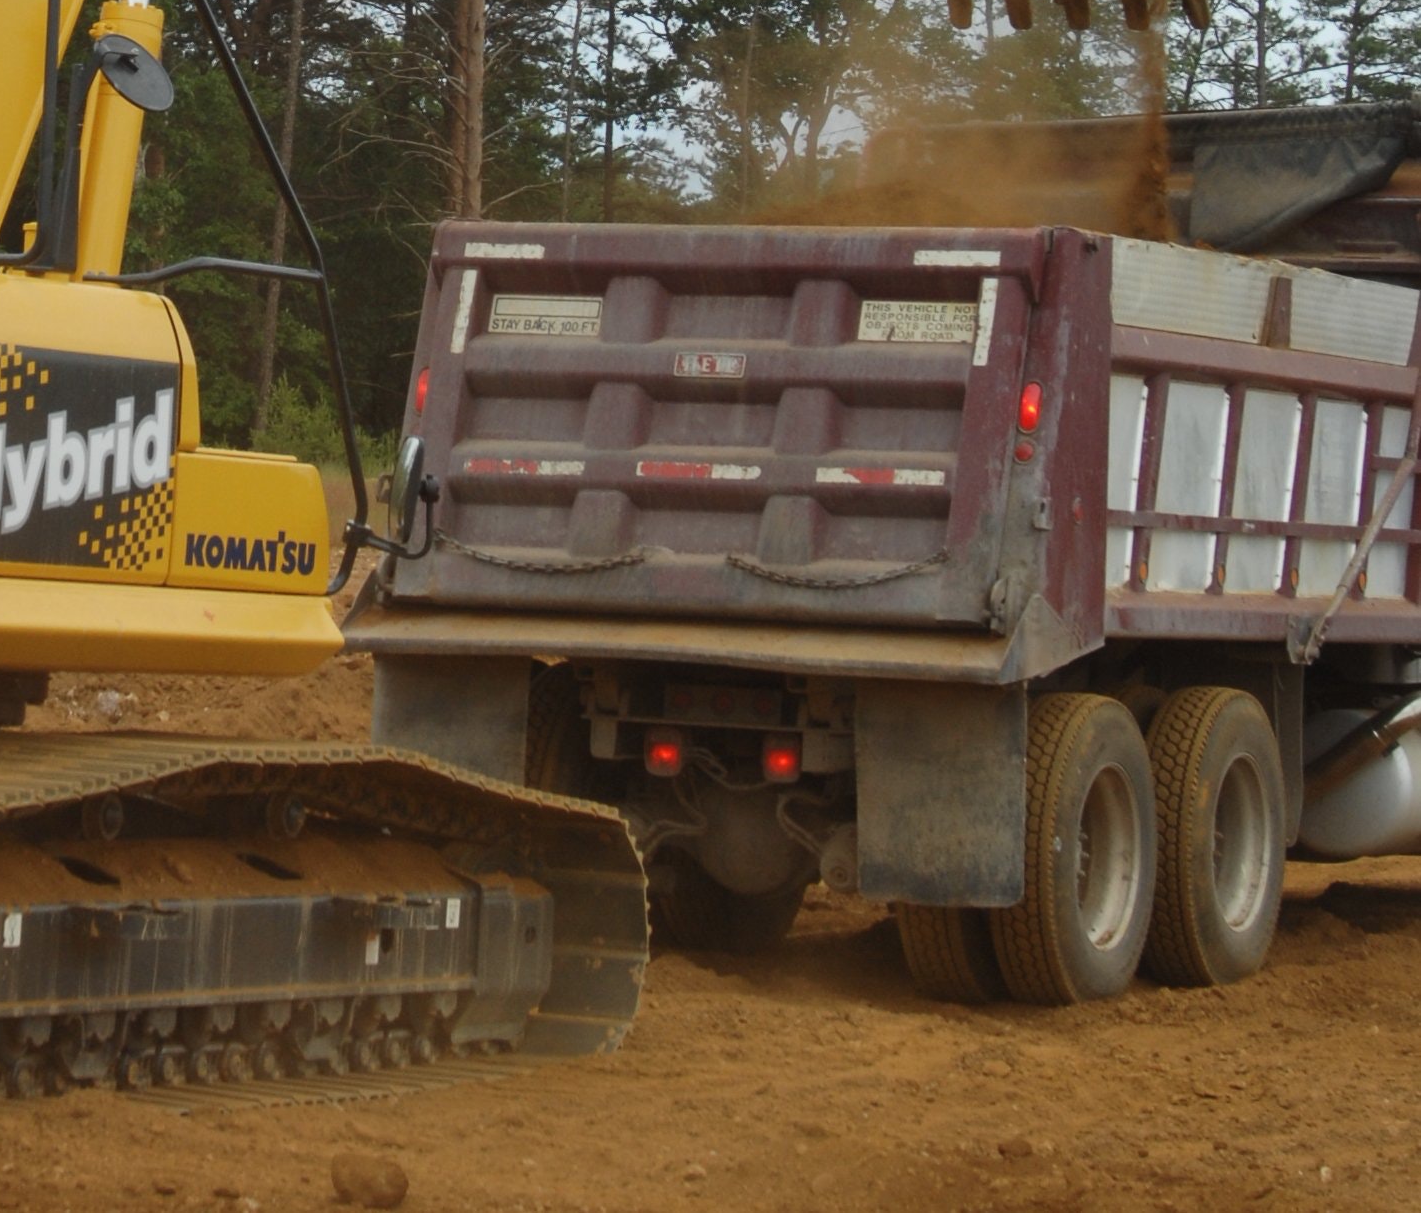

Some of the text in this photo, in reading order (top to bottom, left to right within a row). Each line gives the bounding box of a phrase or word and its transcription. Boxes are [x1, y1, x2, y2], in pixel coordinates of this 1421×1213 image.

[865, 302, 978, 314] THIS VEHICLE NOT
[864, 312, 946, 322] RESPONSIBLE
[491, 318, 520, 330] STAY
[523, 319, 556, 332] BACK
[561, 321, 579, 332] 100
[926, 322, 973, 332] COMING
[921, 331, 954, 340] ROAD
[184, 530, 317, 576] KOMATSU
